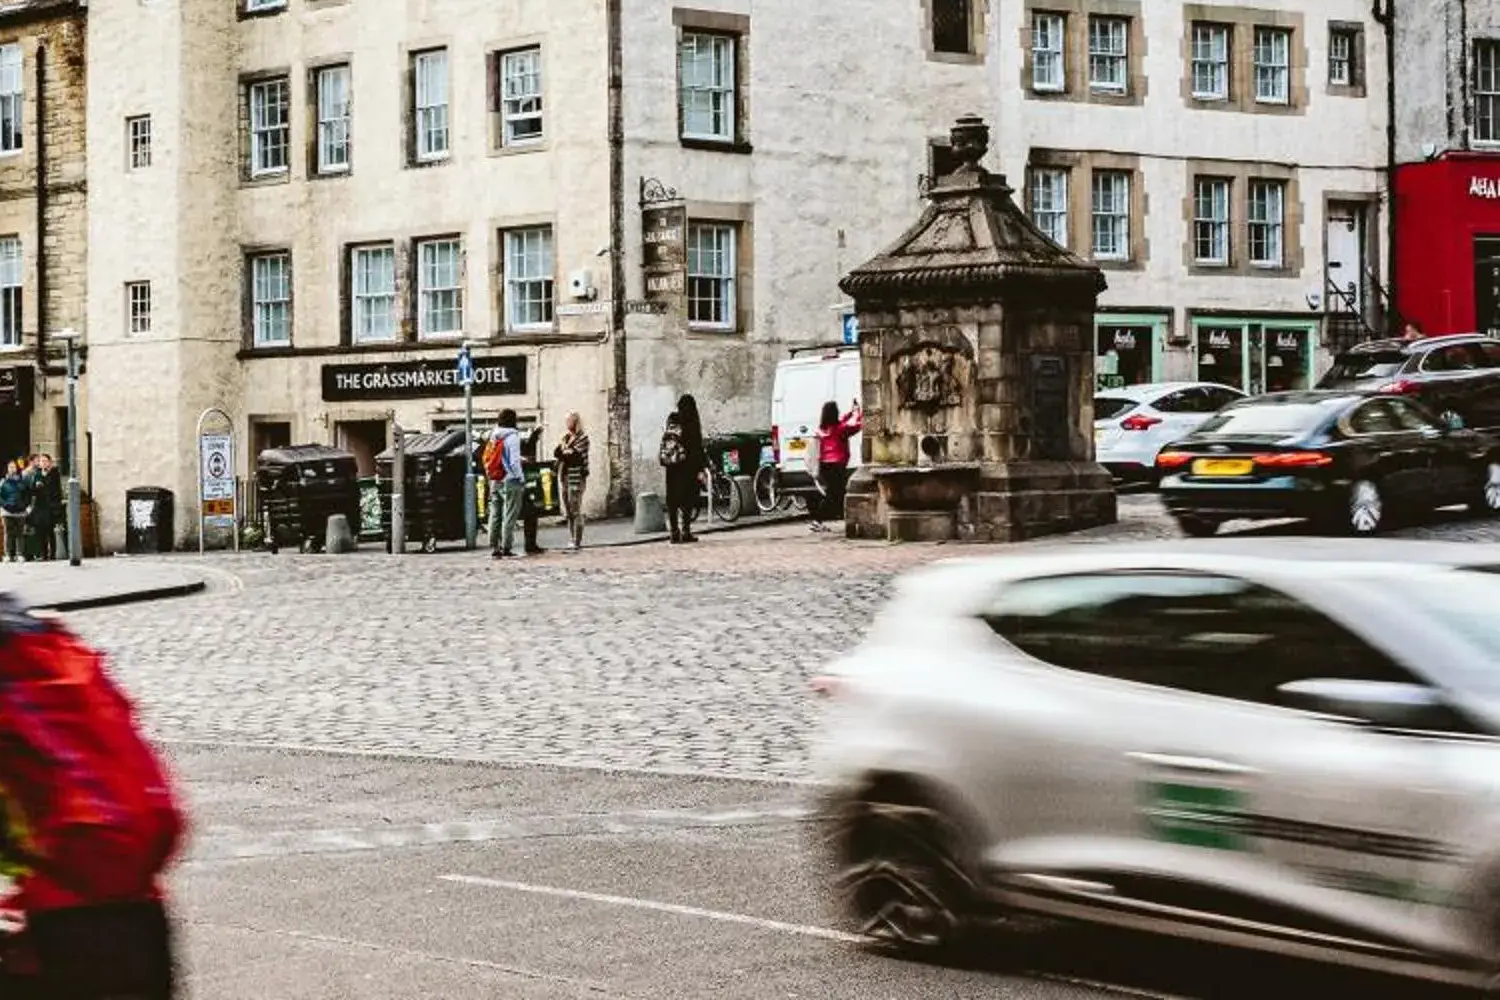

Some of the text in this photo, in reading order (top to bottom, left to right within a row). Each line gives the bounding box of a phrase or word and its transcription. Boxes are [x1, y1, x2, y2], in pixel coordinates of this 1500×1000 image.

[336, 368, 509, 389] THE GRASSMARKET OTEL
